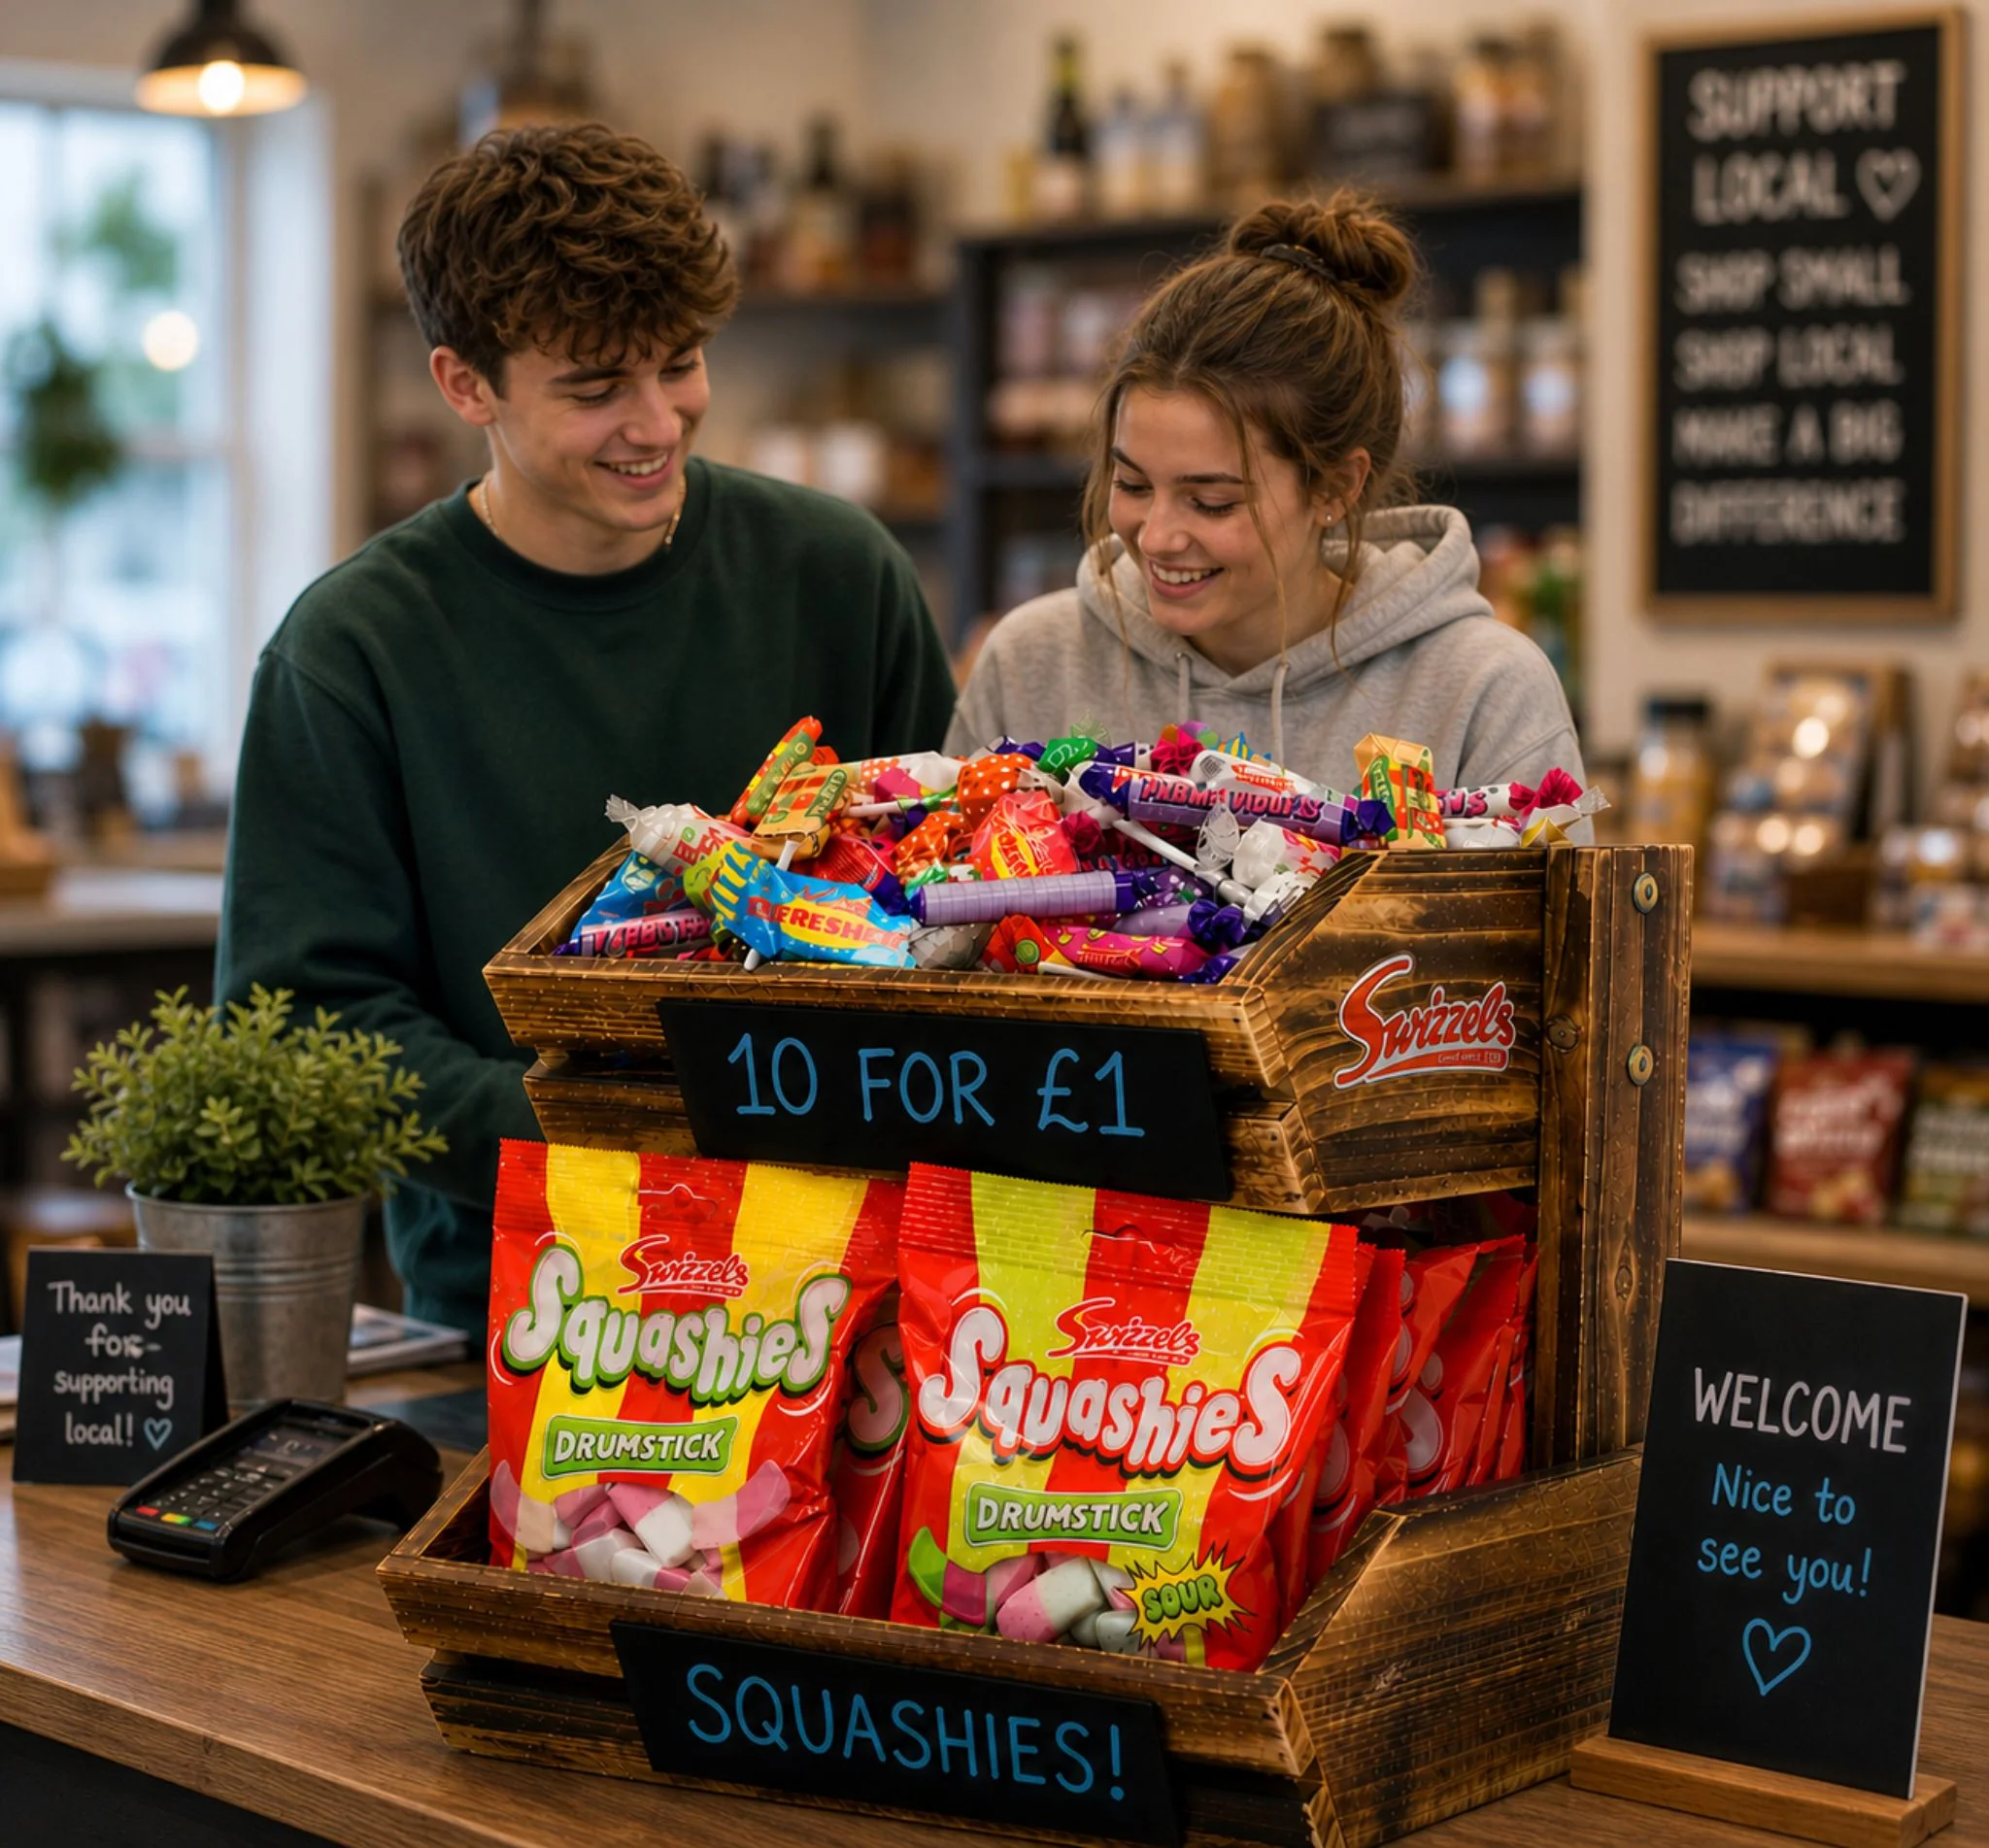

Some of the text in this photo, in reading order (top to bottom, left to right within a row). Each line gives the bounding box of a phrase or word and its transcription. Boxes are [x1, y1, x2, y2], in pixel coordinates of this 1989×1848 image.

[1688, 60, 1905, 142] SUPPORT
[1692, 149, 1847, 225] LOCAL
[1787, 403, 1823, 462] A
[1333, 954, 1516, 1090] Swizzels
[727, 1032, 1145, 1137] 10 FOR £1
[617, 1234, 750, 1295] Swizzels
[47, 1280, 192, 1329] Thank you
[1046, 1297, 1201, 1359] Swizzels
[53, 1366, 174, 1411] supporting
[1695, 1367, 1911, 1453] WELCOME
[65, 1412, 133, 1447] local!
[554, 1428, 725, 1463] DRUMSTICK
[976, 1496, 1168, 1534] DRUMSTICK
[1712, 1462, 1855, 1525] Nice to
[1142, 1575, 1224, 1622] SOUR
[1698, 1538, 1871, 1604] see you!
[687, 1663, 1125, 1800] SQUASHIES!
